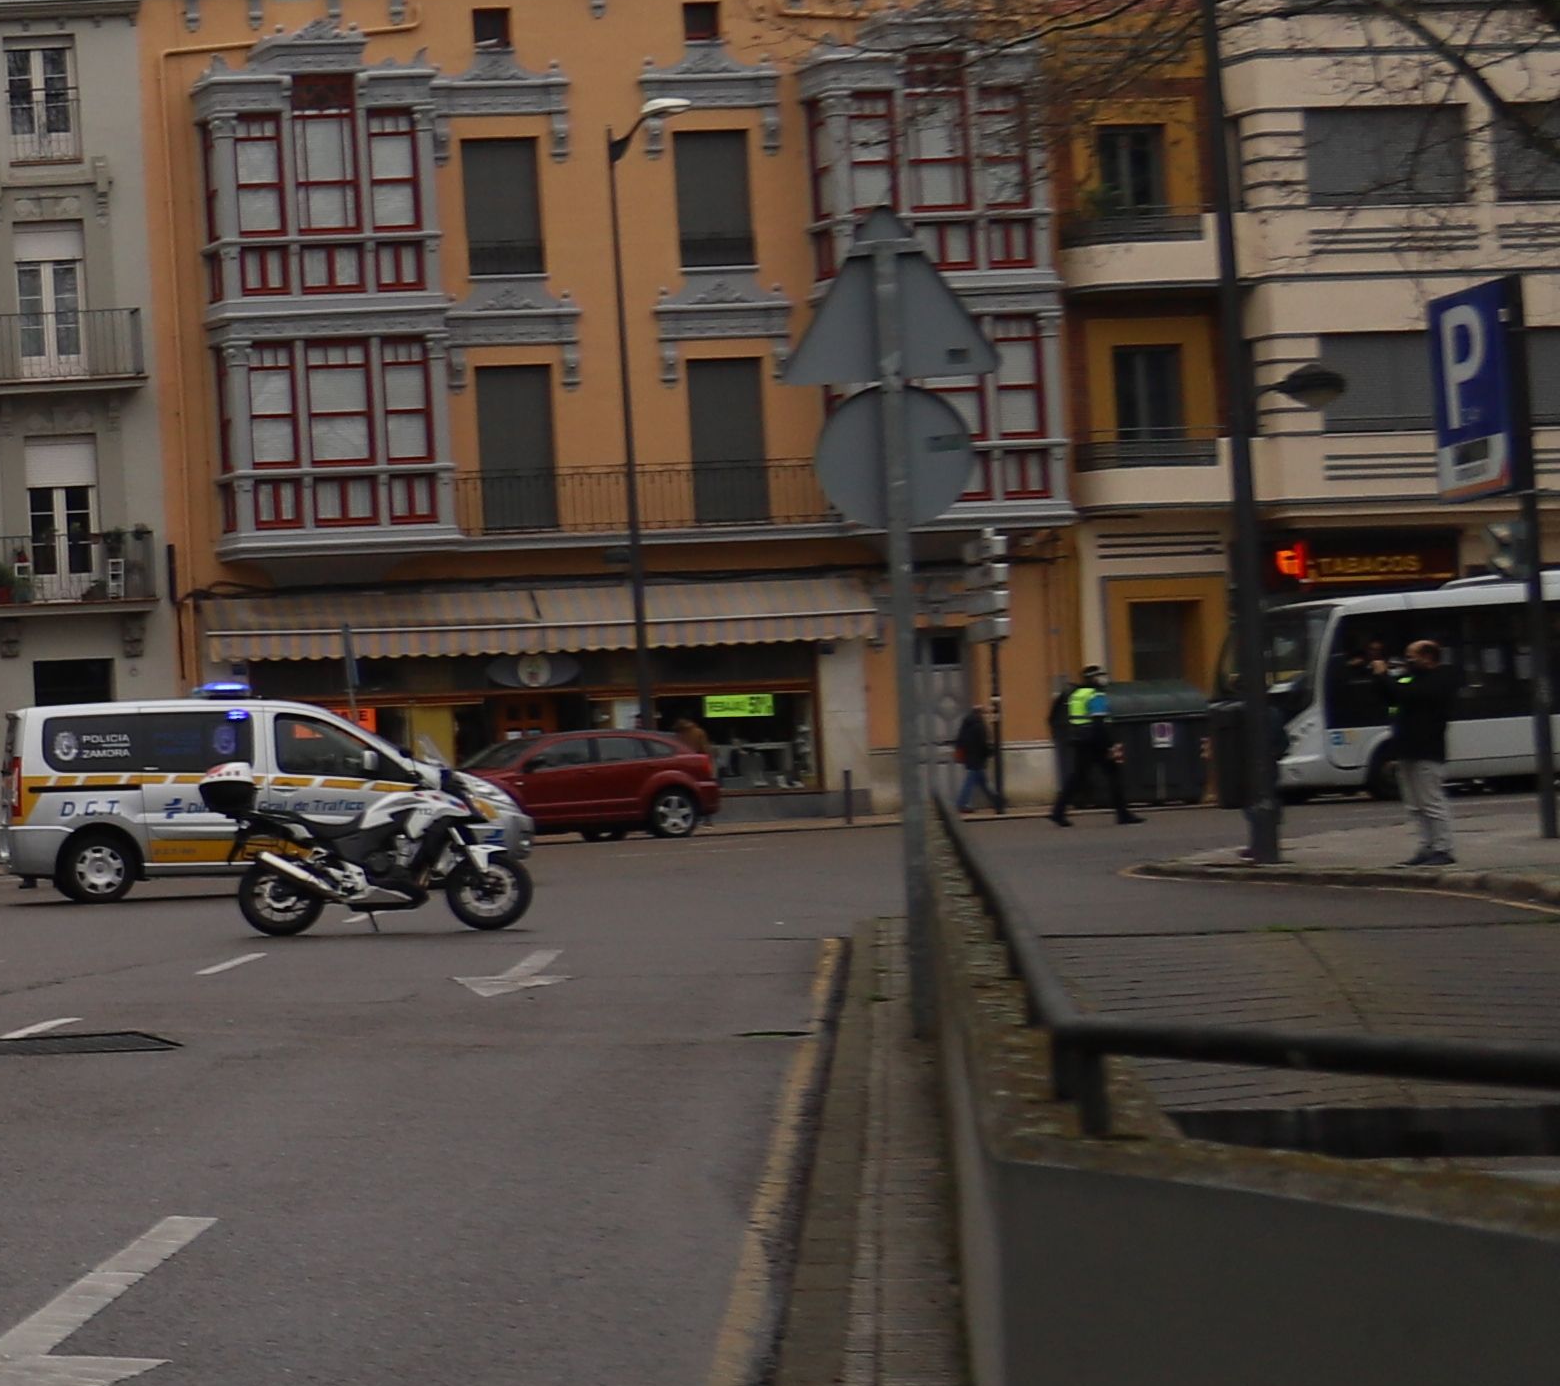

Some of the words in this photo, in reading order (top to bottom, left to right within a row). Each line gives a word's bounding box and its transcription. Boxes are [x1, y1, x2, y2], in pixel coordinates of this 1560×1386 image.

[1440, 304, 1485, 430] P
[82, 733, 131, 744] POLICIA
[82, 748, 132, 758] ZAMORA
